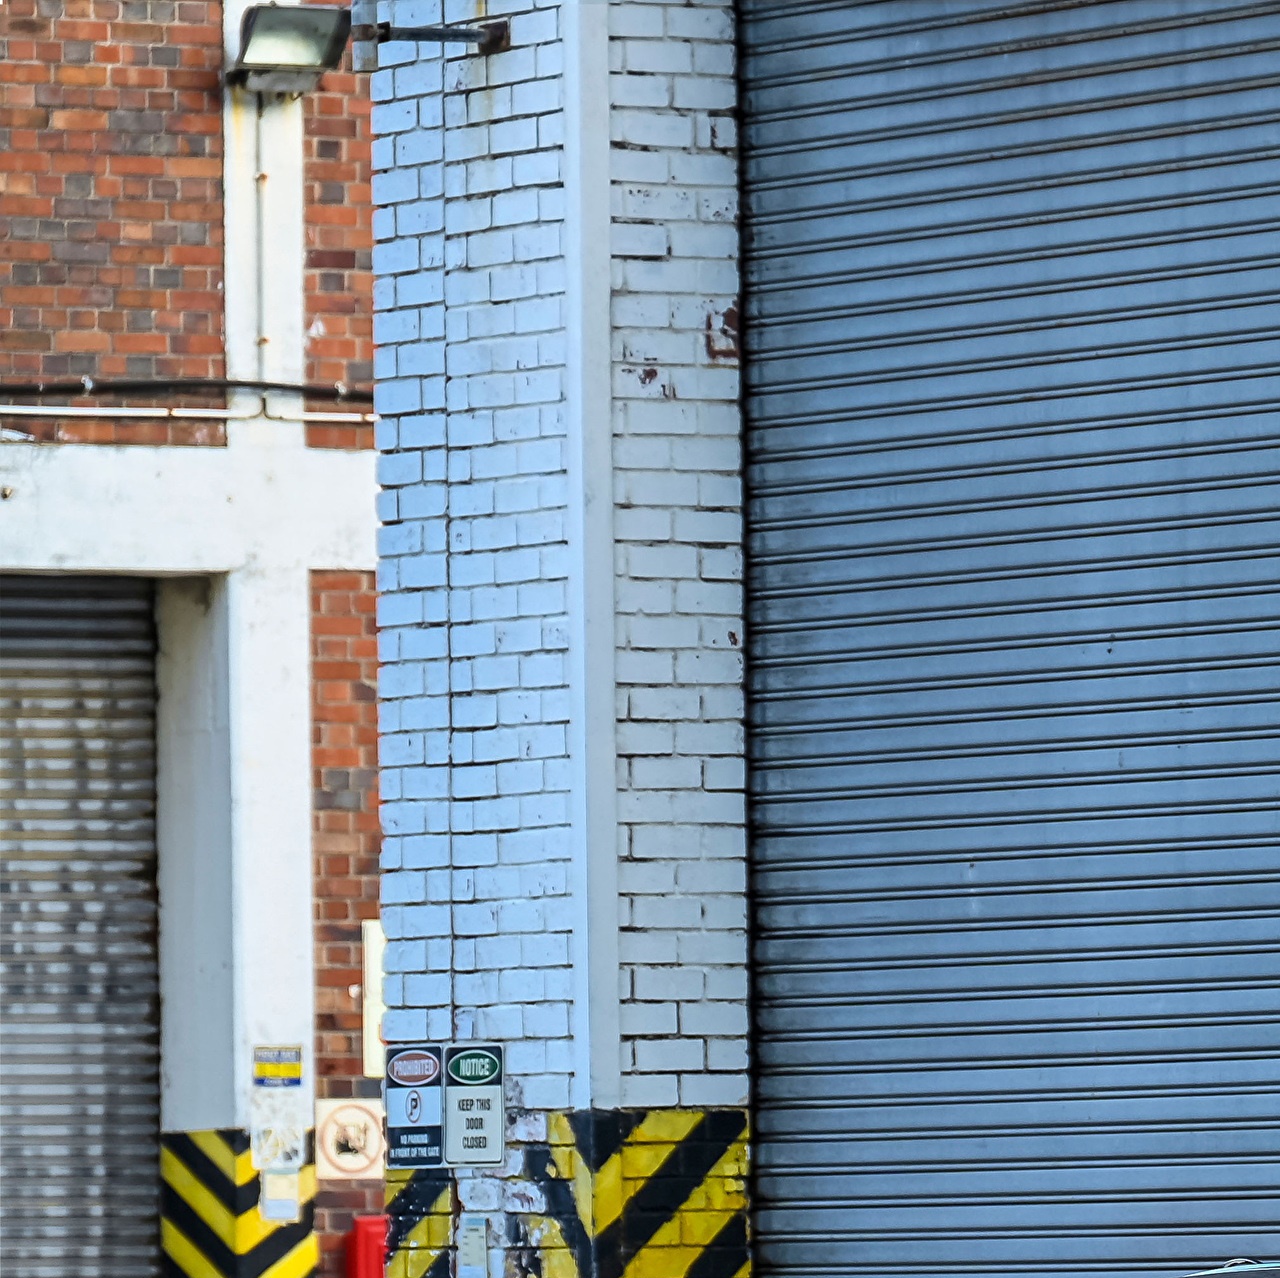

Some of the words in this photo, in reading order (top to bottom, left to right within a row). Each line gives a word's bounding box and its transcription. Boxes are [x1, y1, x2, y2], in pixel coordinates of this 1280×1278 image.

[393, 1059, 434, 1076] PROHIBITED
[459, 1058, 490, 1076] NOTICE
[458, 1099, 474, 1111] KEEP
[475, 1098, 491, 1110] THIS
[465, 1117, 483, 1129] DOOR
[462, 1136, 487, 1149] CLOSED
